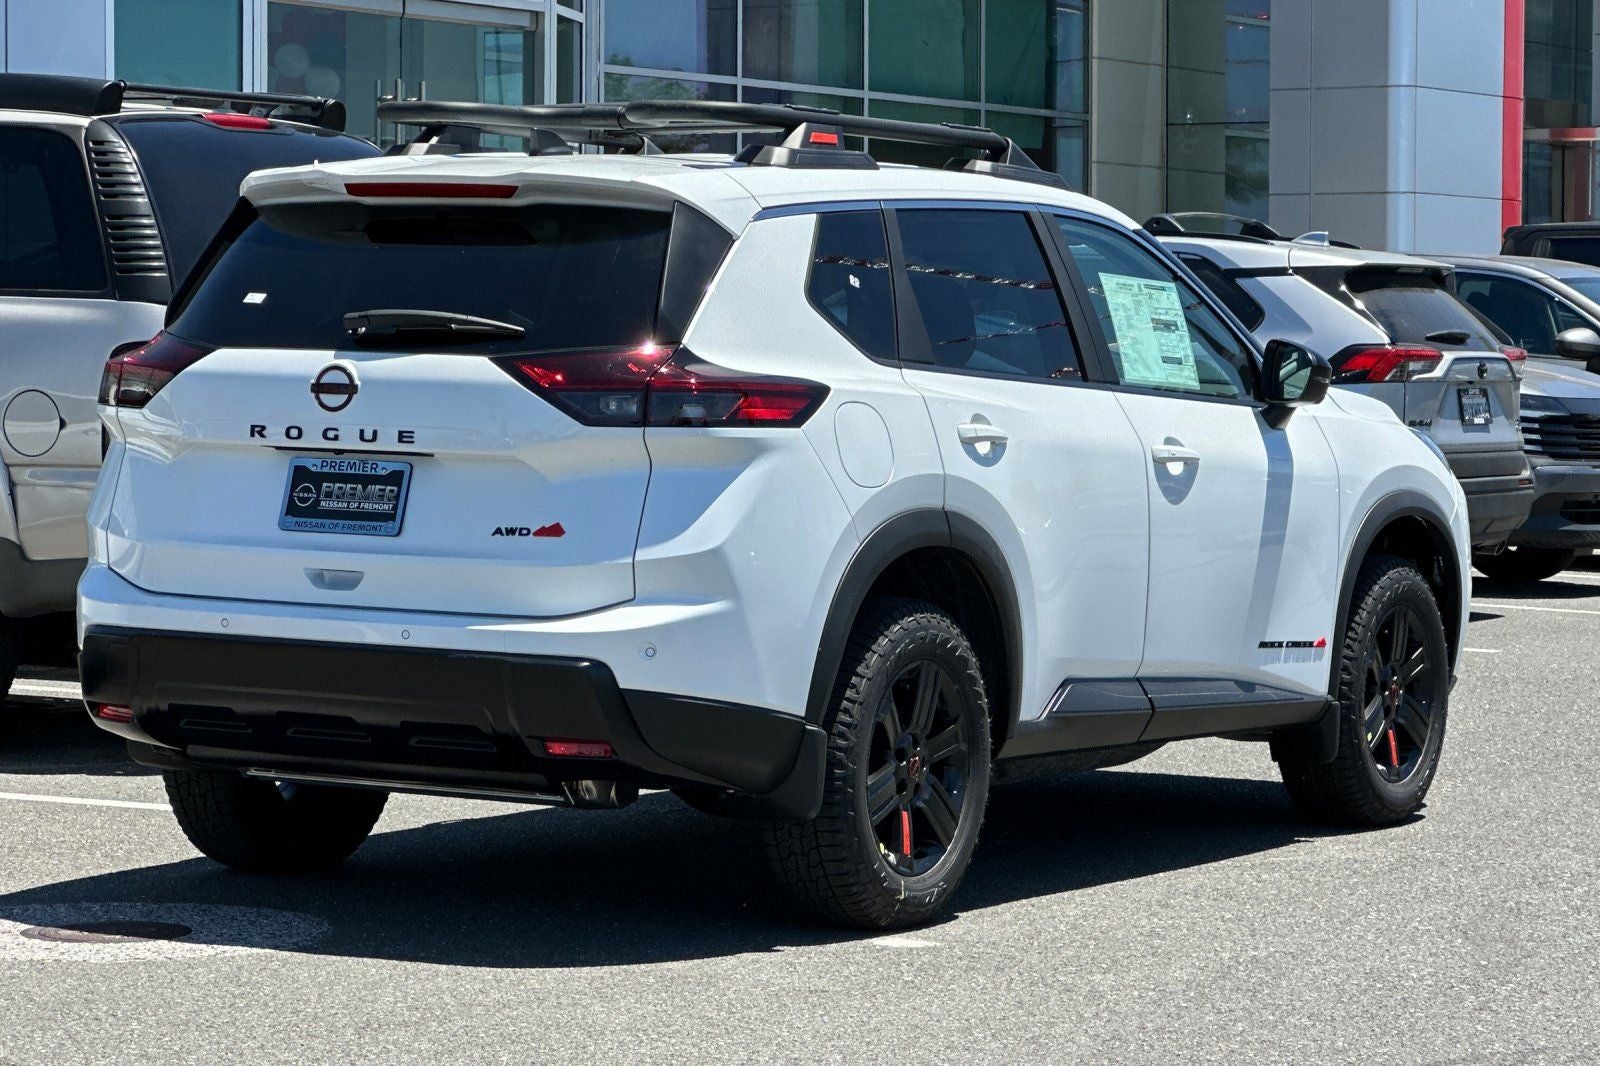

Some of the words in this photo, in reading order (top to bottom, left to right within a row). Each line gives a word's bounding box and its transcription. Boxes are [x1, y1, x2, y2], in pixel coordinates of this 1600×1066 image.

[249, 424, 415, 444] ROGUE
[320, 460, 379, 473] PREMIER
[320, 483, 398, 502] PREMIER
[320, 501, 346, 509] NISSAN
[360, 502, 394, 511] FREMONT
[294, 521, 326, 530] NISSAN
[328, 522, 340, 531] OF
[341, 523, 384, 533] FREMONT
[491, 526, 532, 537] AWD
